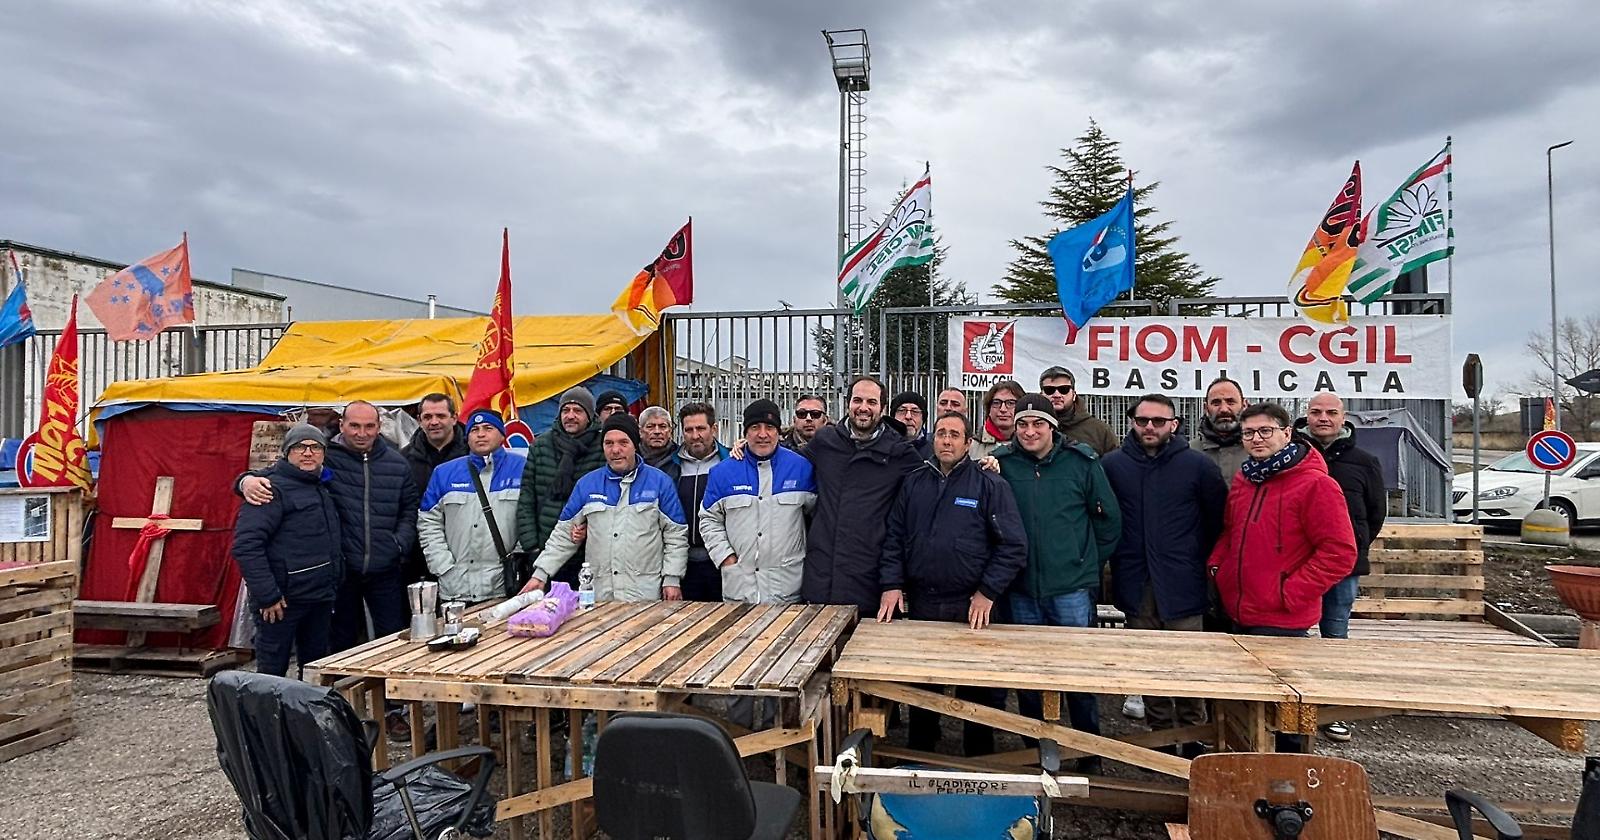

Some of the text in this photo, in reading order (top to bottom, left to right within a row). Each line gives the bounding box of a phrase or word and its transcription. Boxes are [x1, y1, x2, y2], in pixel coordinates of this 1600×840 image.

[1088, 324, 1228, 363] FIOM
[1279, 324, 1412, 364] CGIL
[985, 354, 1004, 364] FIOM
[928, 779, 1008, 790] GLADIATORE
[936, 787, 985, 796] PEPPE
